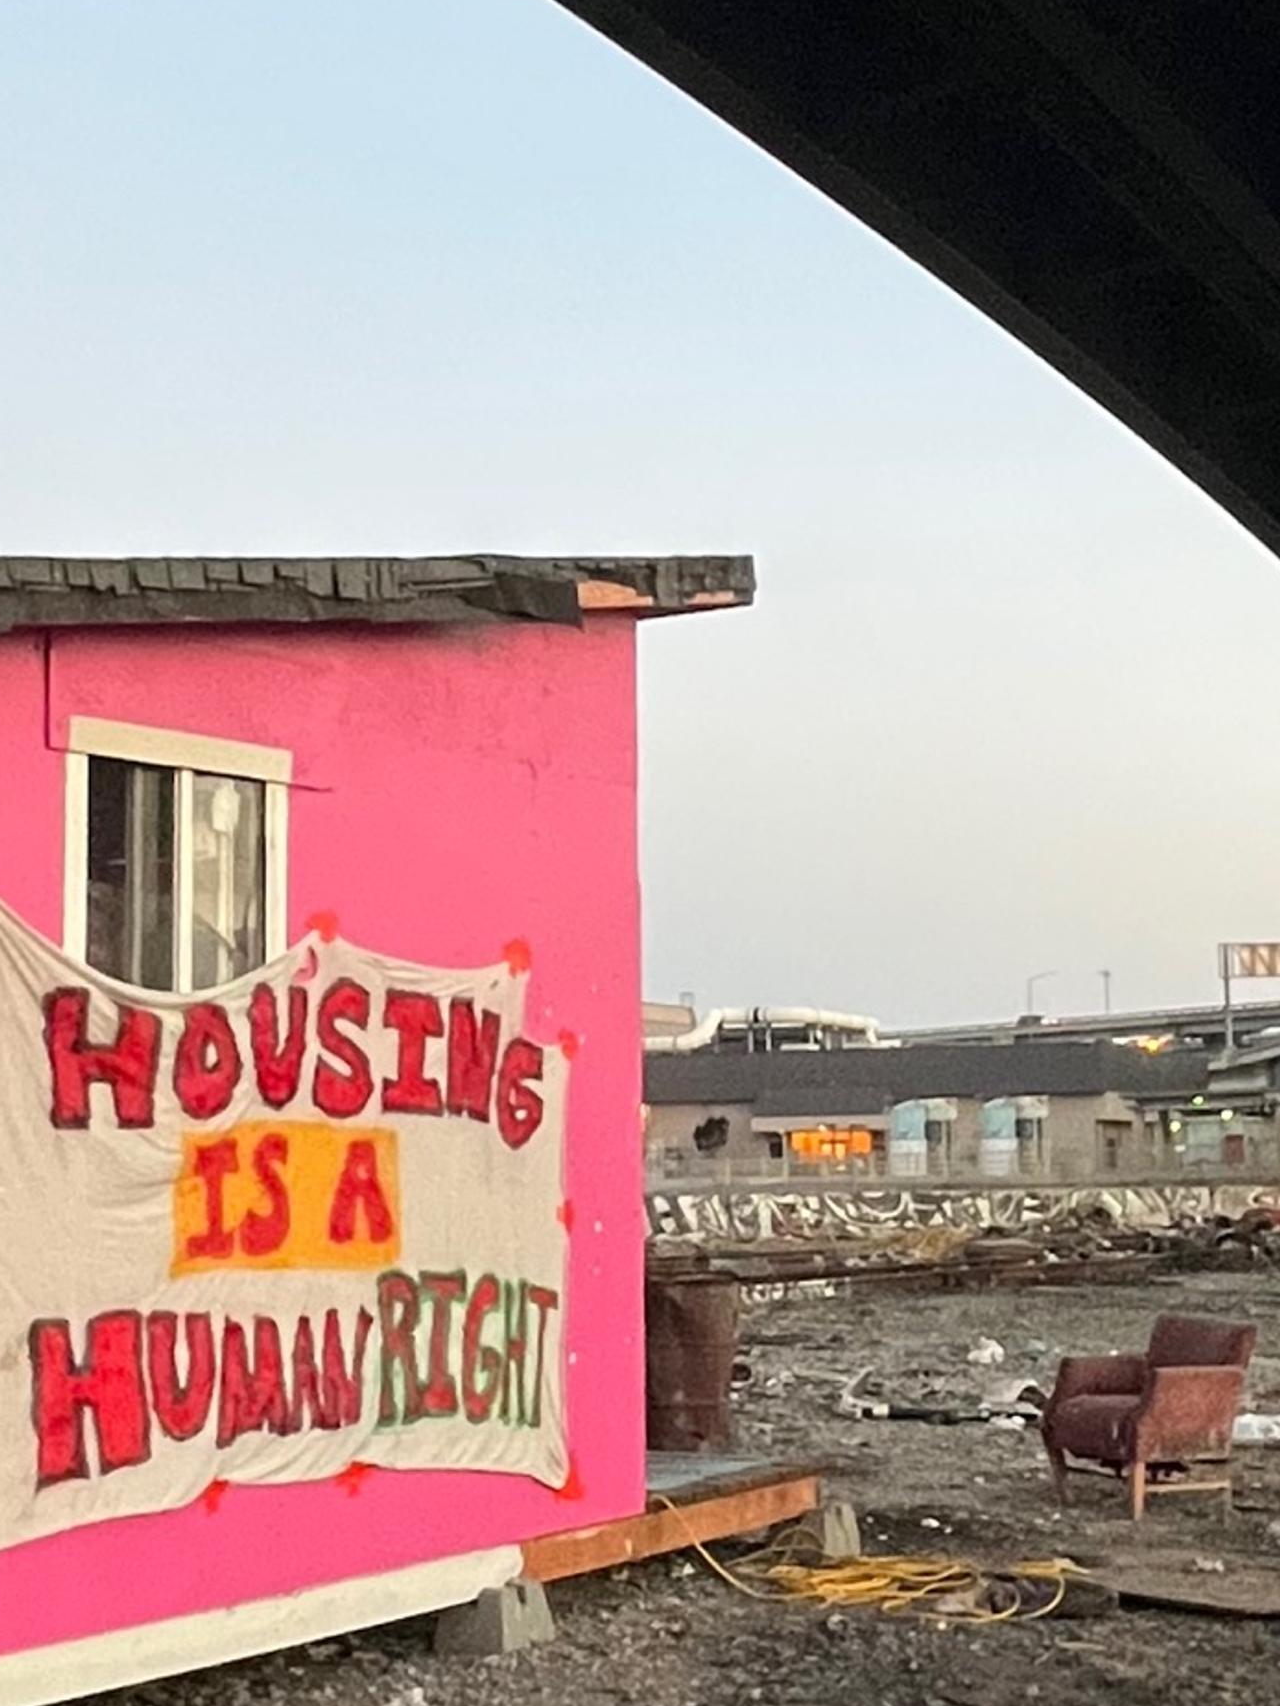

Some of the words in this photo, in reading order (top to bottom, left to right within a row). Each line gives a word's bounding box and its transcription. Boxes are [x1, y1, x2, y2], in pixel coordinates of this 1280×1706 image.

[42, 979, 544, 1149] HOUSING
[186, 1134, 290, 1258] IS
[329, 1141, 394, 1244] A
[28, 1307, 374, 1489] HUMAN
[376, 1270, 558, 1429] RIGHT
